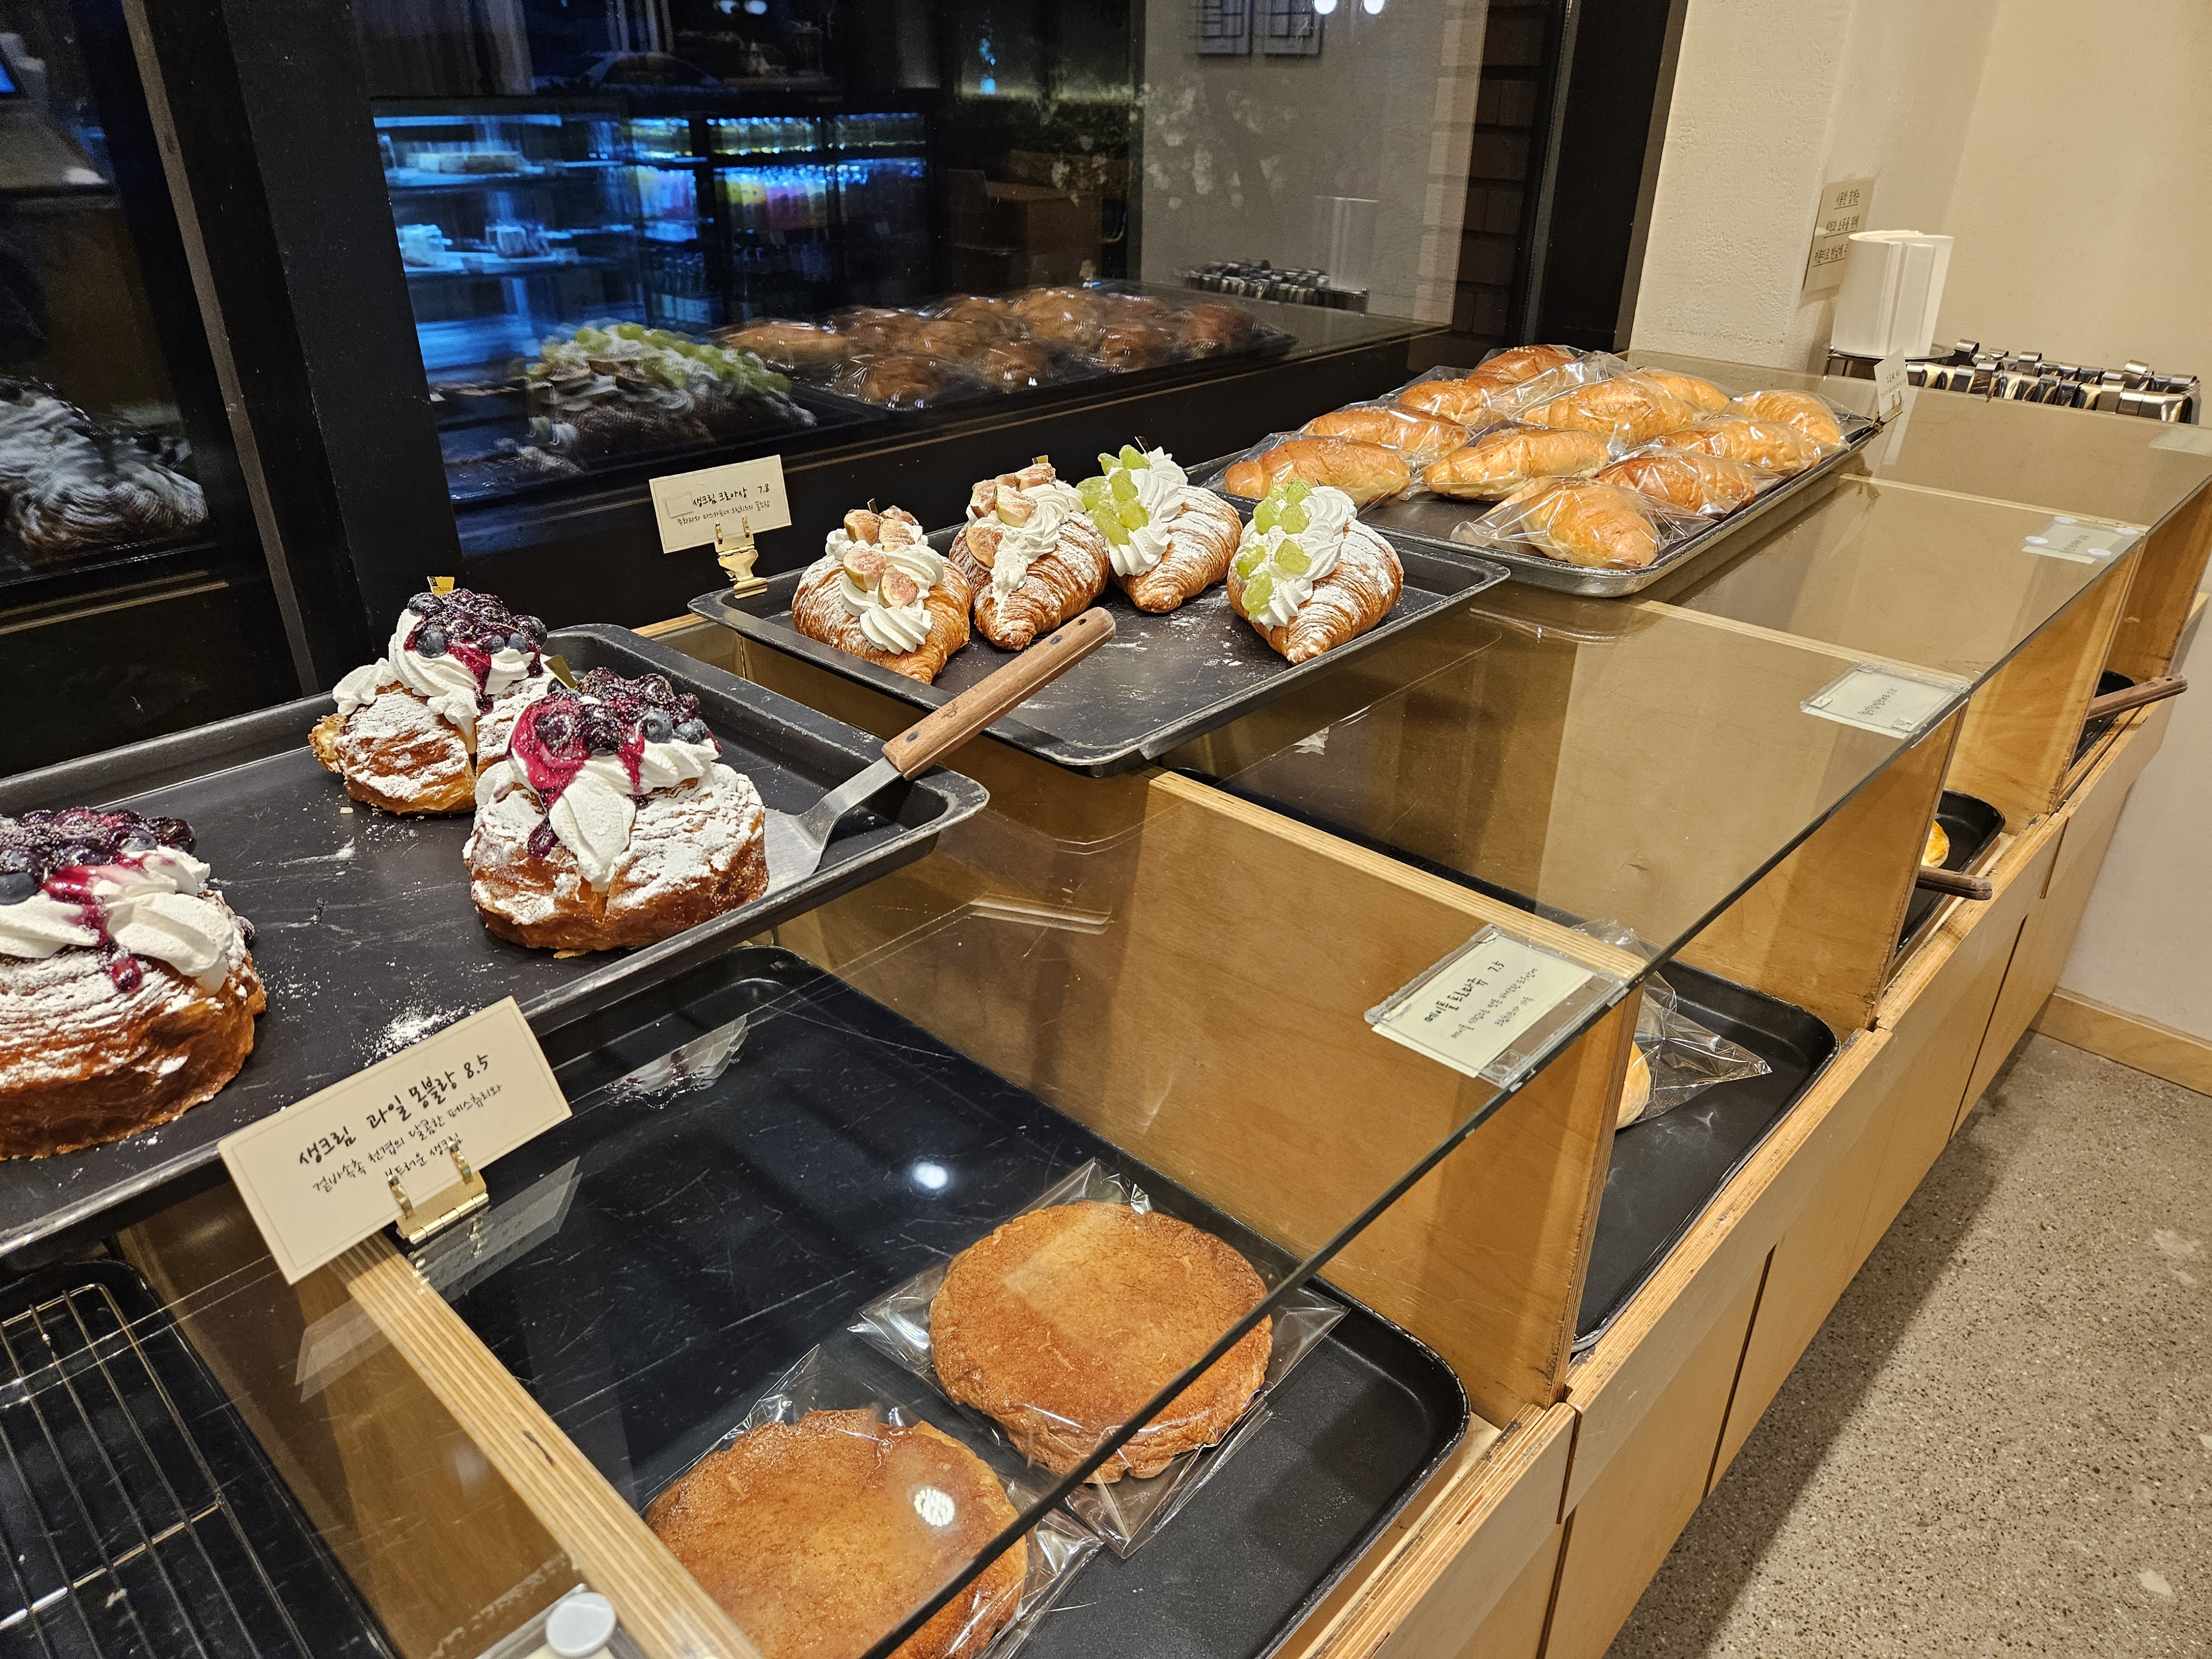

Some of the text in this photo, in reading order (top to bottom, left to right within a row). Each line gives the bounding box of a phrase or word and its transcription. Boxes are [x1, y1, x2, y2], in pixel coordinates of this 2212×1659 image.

[1836, 189, 1860, 206] 사용한 집게는
[1837, 216, 1850, 232] 소독을
[1850, 214, 1860, 229] 위해
[1813, 248, 1830, 264] 카운터로
[1830, 244, 1844, 259] 반납해
[692, 483, 769, 508] 생크림 크로아상 7.8
[703, 509, 729, 519] 마스카포네
[731, 504, 753, 514] 크림치즈의
[754, 500, 770, 512] 꿀조합
[1423, 960, 1505, 1022] 메이플 프로마쥬 7.5
[1451, 1023, 1475, 1039] 메이플
[1468, 1009, 1491, 1024] 시럽으로
[1488, 998, 1503, 1008] 만든
[1499, 983, 1521, 999] 바삭한
[1494, 997, 1534, 1027] 크림치즈가 가득
[299, 1054, 488, 1164] 생크림 과일 몽블랑 8.5
[312, 1084, 502, 1193] 겉바속촉 천겹의 달콤한 페스츄리와
[430, 1132, 463, 1156] 생크림
